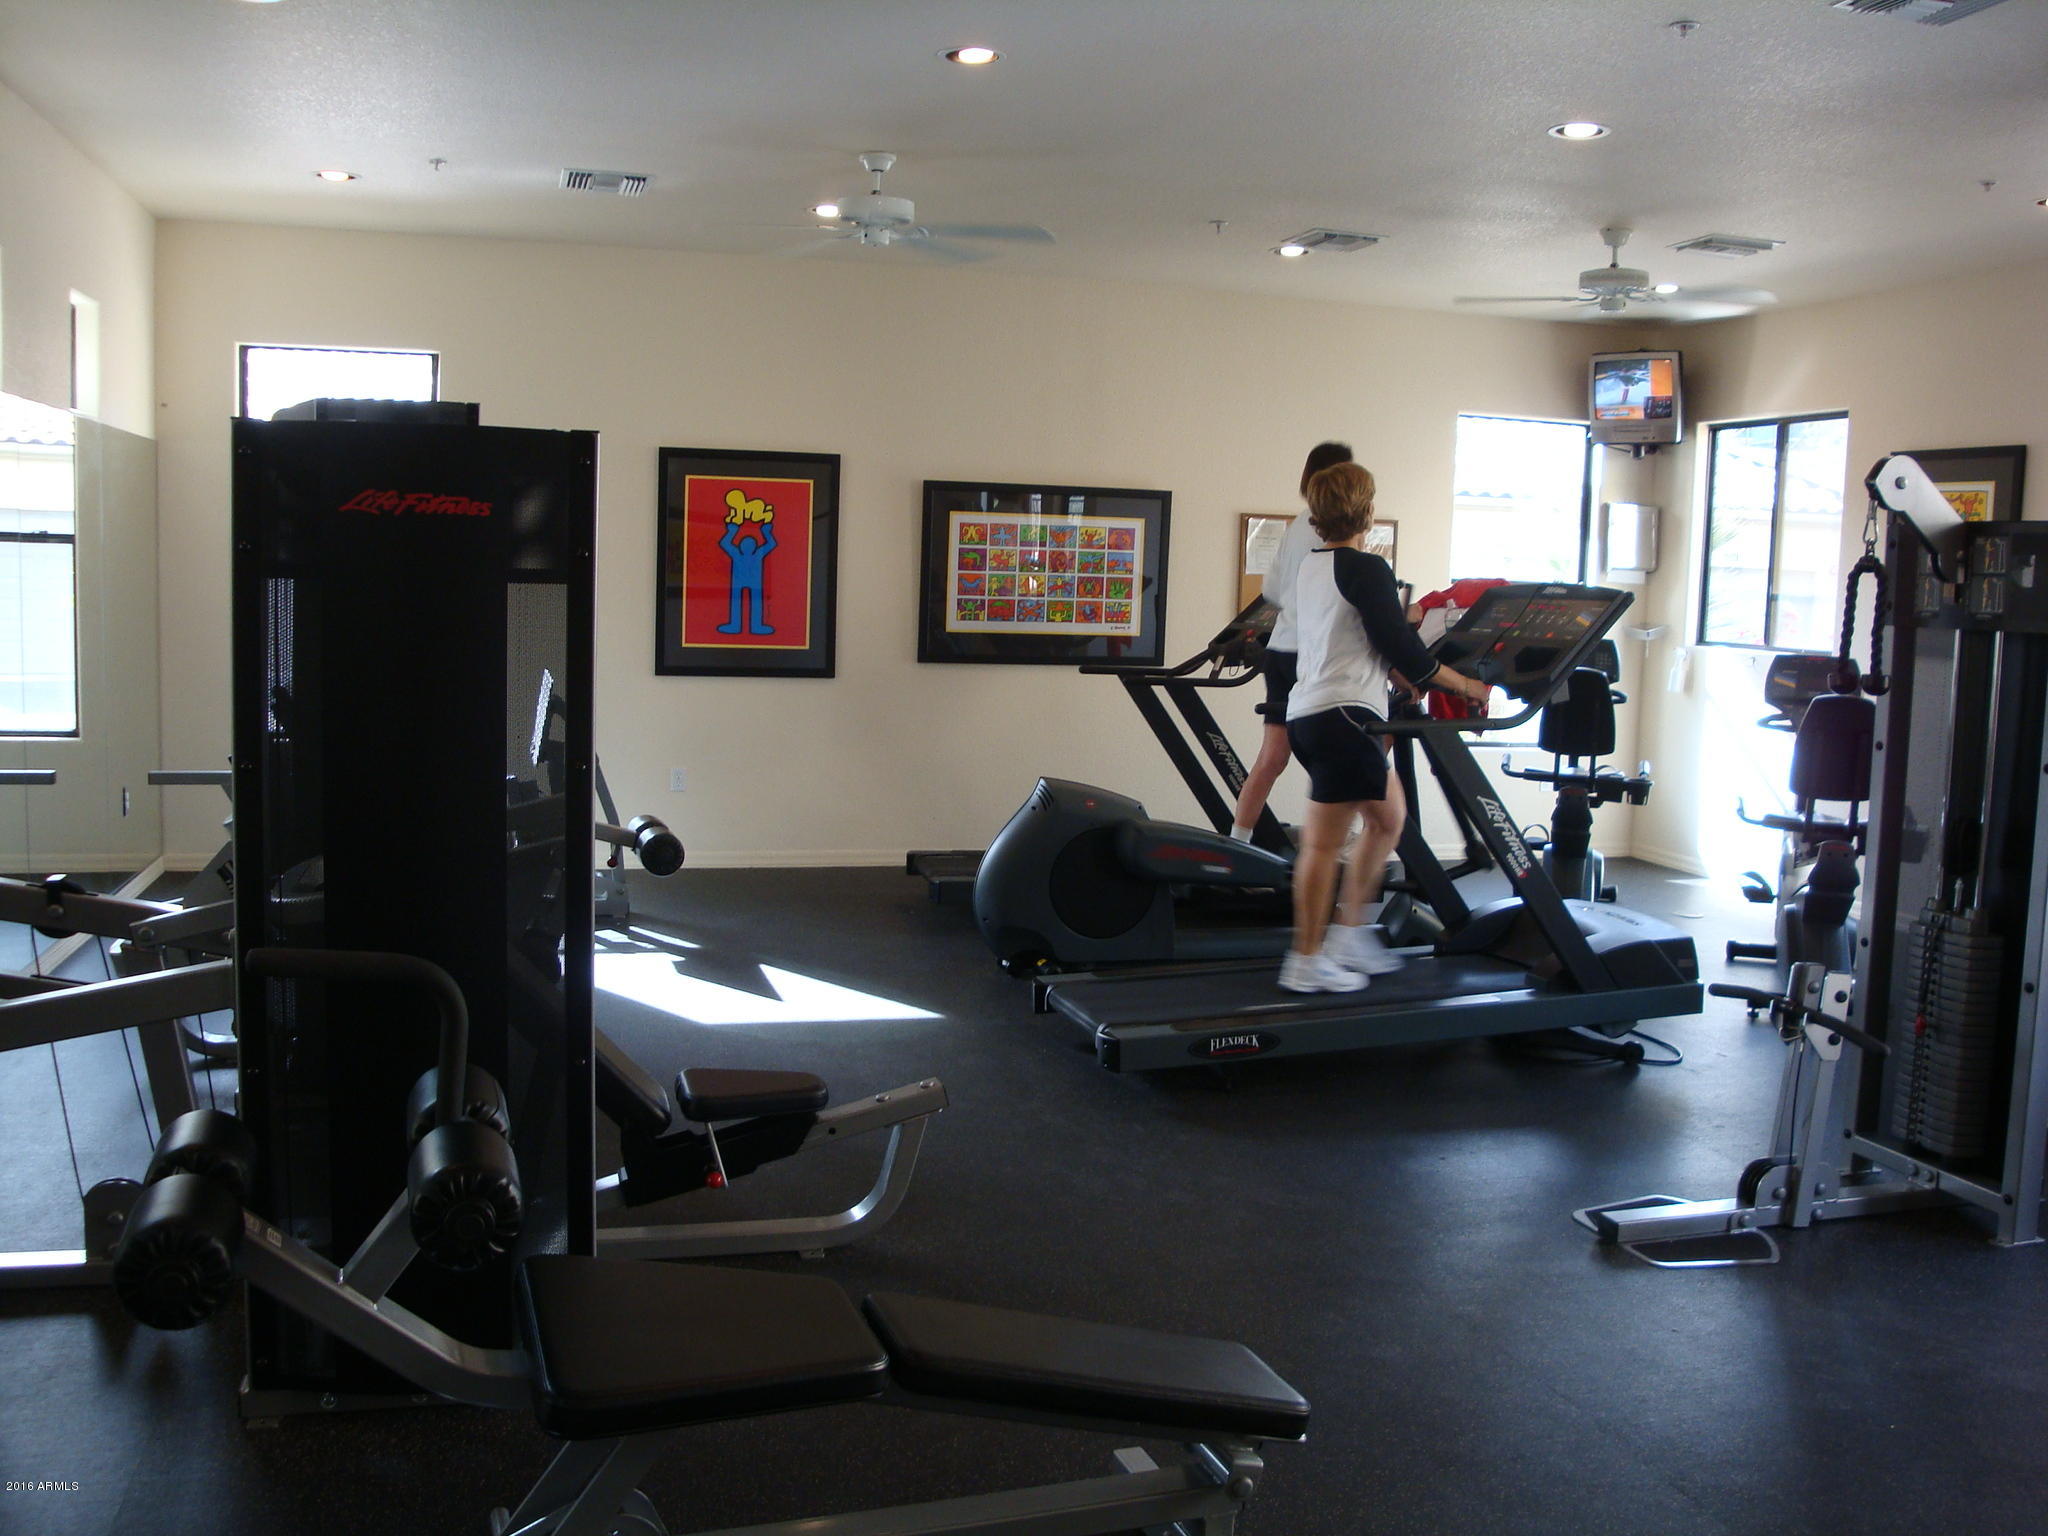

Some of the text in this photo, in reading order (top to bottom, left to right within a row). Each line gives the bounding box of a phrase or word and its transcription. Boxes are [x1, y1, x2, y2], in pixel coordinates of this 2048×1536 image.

[339, 489, 493, 516] Life Fitness
[1476, 795, 1531, 869] Life Fitness
[1210, 1034, 1259, 1051] FLEXDECK
